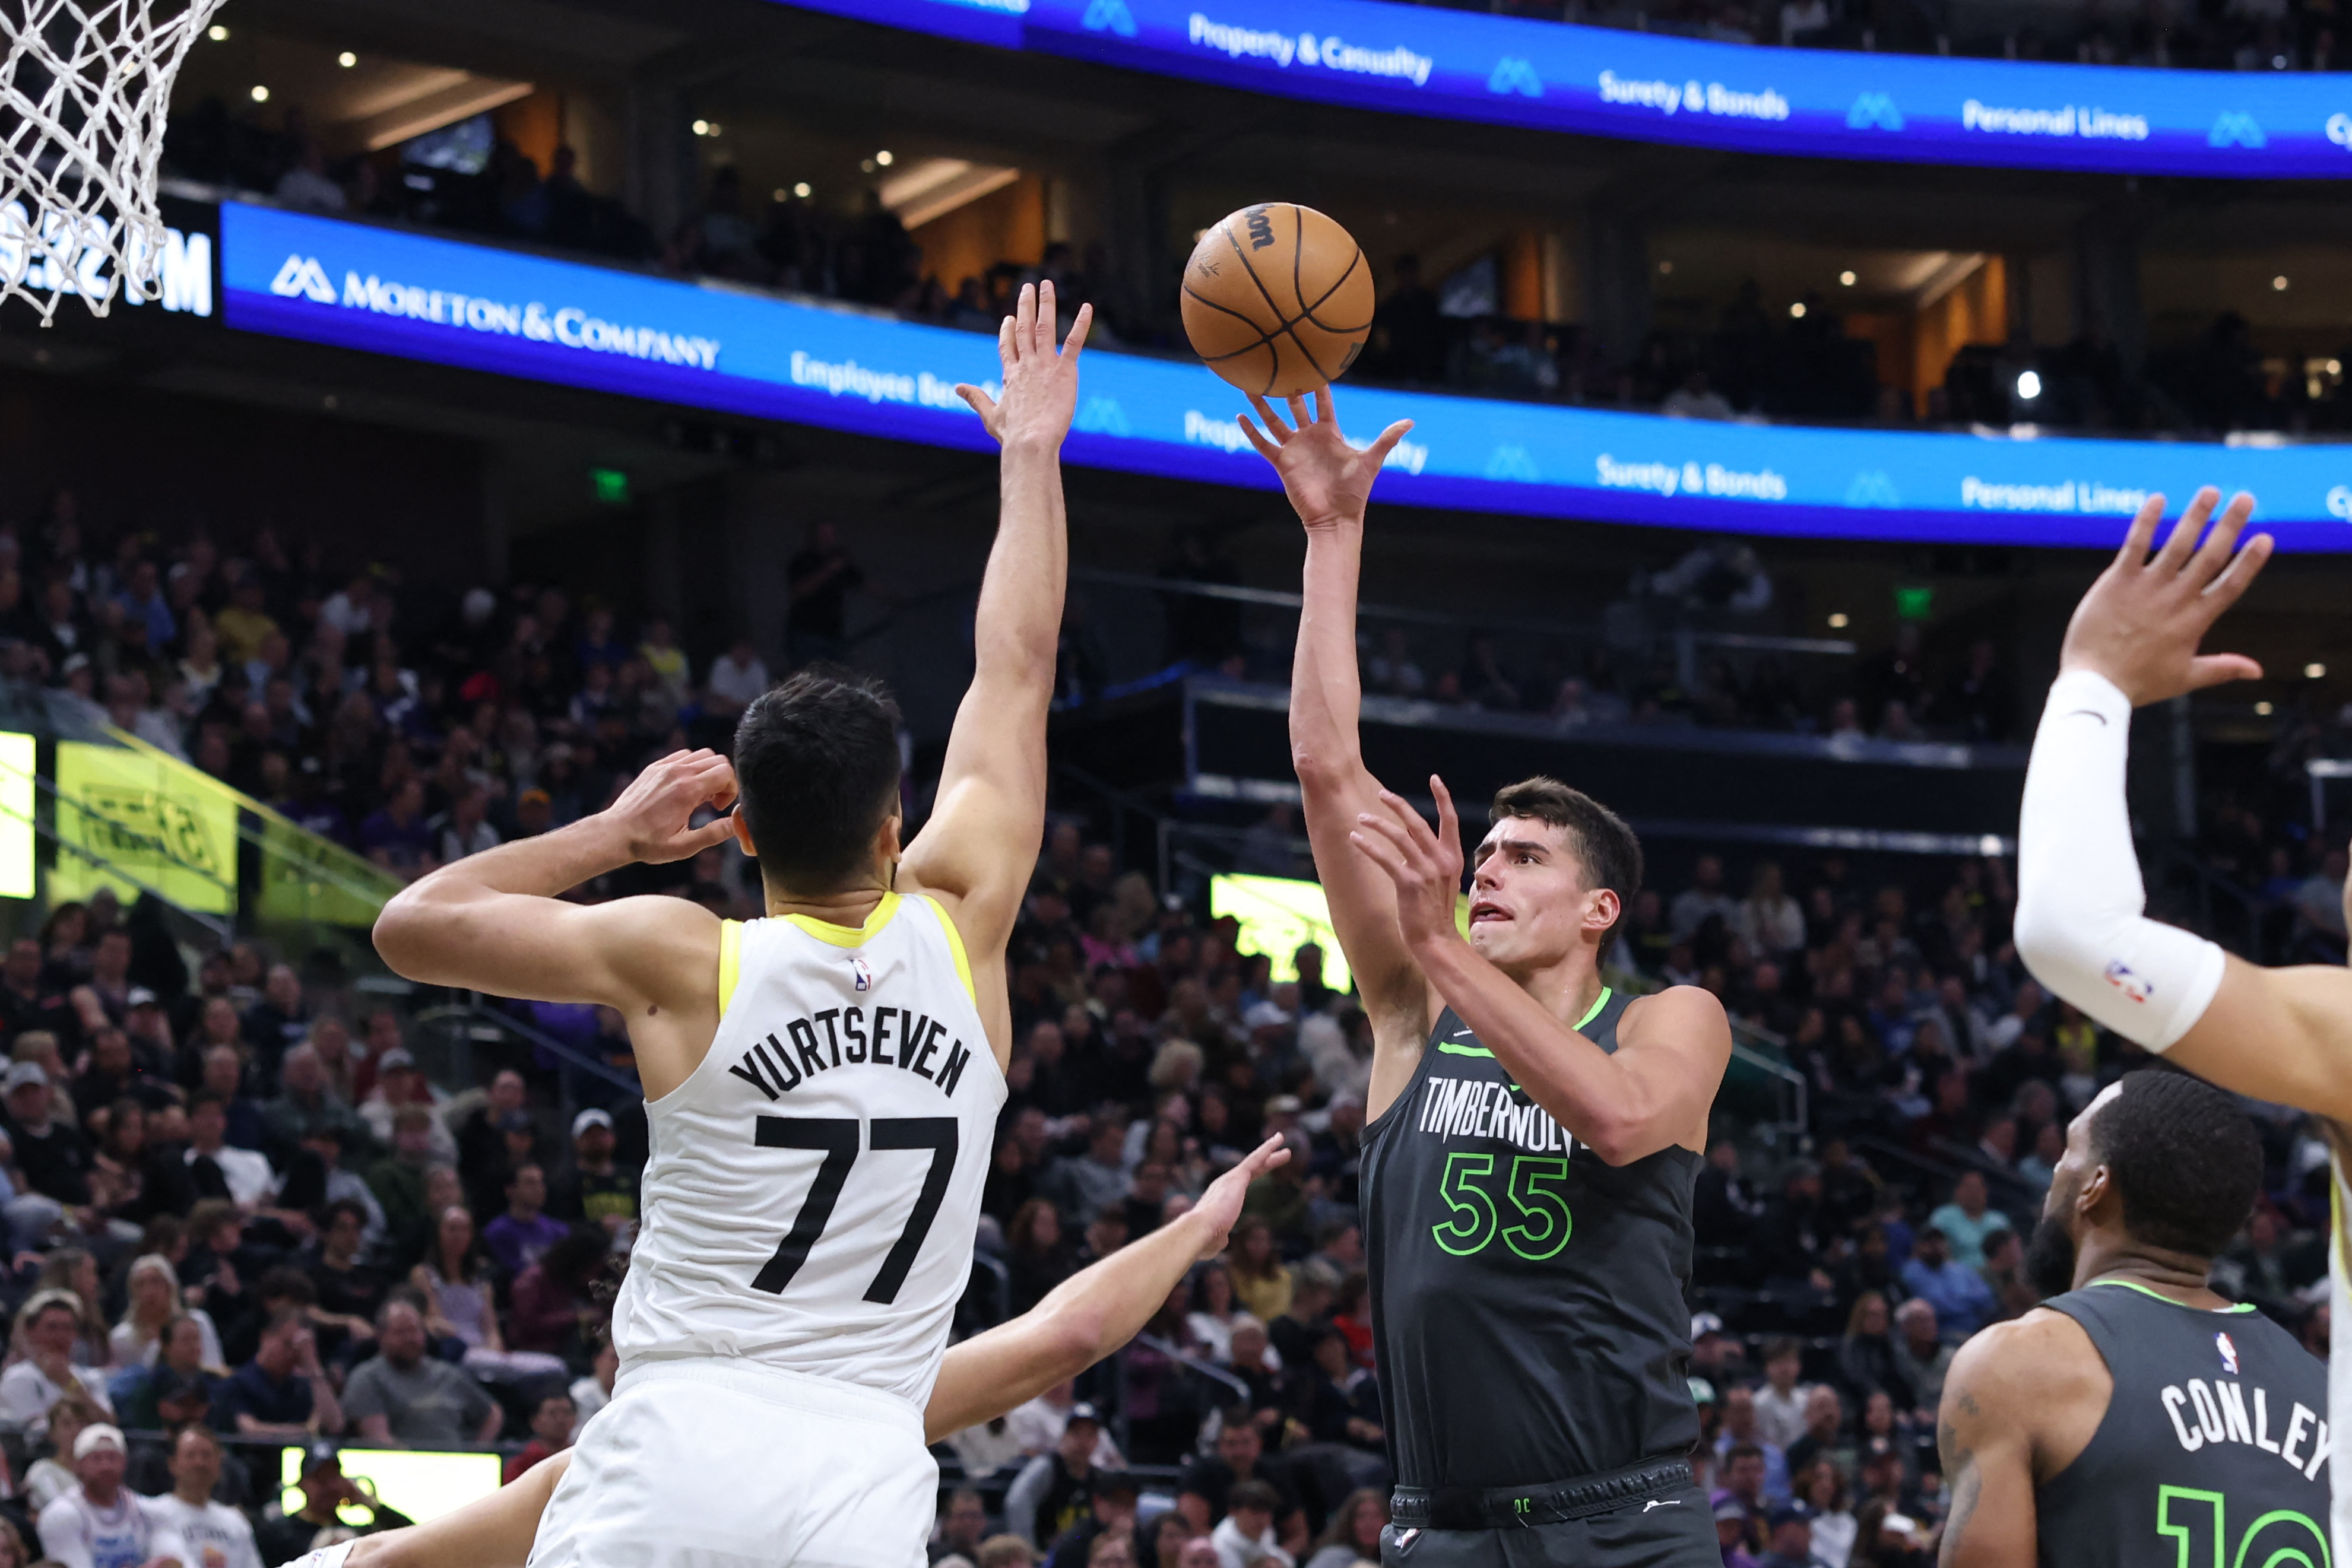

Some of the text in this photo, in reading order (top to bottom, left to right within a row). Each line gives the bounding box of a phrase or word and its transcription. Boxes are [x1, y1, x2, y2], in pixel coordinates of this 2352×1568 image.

[1189, 12, 1432, 87] Property & Casualty
[1599, 69, 1789, 121] Surety & Bonds
[1963, 99, 2149, 141] Personal Lines
[791, 351, 916, 404] Employee
[1596, 453, 1787, 500] Surety & Bonds
[1961, 477, 2076, 511] Personal
[728, 1006, 971, 1102] YURTSEVEN
[1419, 1077, 1590, 1158] TIMBERWOL
[750, 1115, 959, 1305] 77
[1432, 1153, 1572, 1261] 55
[2161, 1378, 2331, 1482] CONLEY
